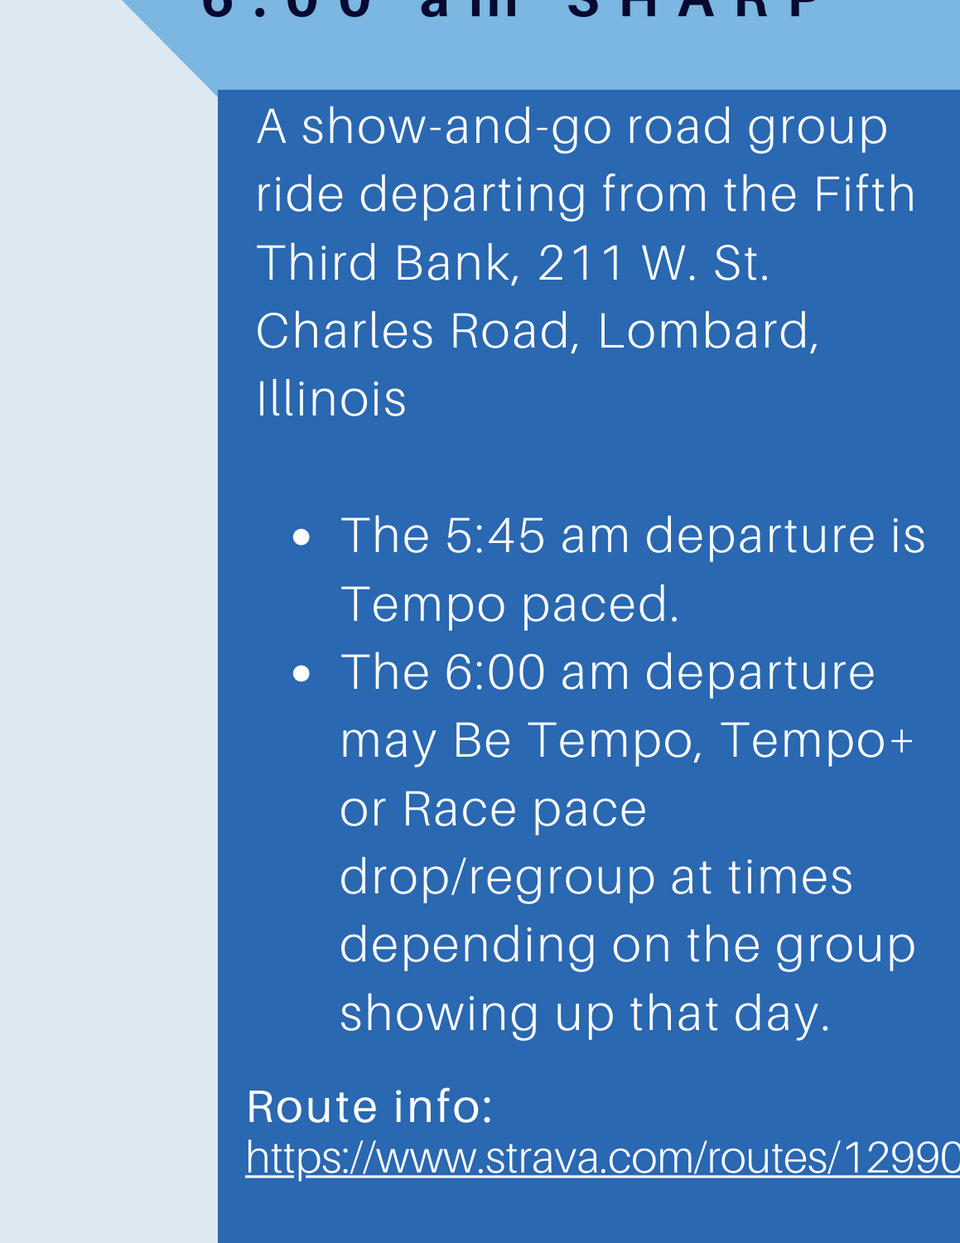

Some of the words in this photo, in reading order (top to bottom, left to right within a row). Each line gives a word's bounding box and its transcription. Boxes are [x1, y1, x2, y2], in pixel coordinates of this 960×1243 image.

[257, 109, 286, 143] A
[303, 106, 610, 154] show-and-go
[630, 106, 729, 144] road
[749, 116, 886, 154] group
[259, 174, 342, 212] ride
[361, 174, 583, 222] departing
[603, 173, 705, 212] from
[724, 174, 795, 212] the
[817, 173, 913, 211] Fifth
[257, 243, 375, 280] Third
[398, 243, 518, 286] Bank,
[539, 245, 617, 280] 211
[642, 245, 694, 280] W.
[715, 245, 767, 280] St.
[258, 311, 432, 348] Charles
[454, 311, 577, 354] Road,
[601, 311, 817, 354] Lombard,
[260, 379, 405, 416] Illinois
[341, 515, 428, 553] The
[447, 518, 543, 553] 5:45
[562, 525, 627, 553] am
[647, 516, 874, 562] departure
[894, 518, 924, 553] is
[341, 587, 504, 631] Tempo
[524, 584, 677, 631] paced.
[341, 652, 428, 690] The
[447, 654, 544, 690] 6:00
[562, 662, 627, 690] am
[647, 652, 874, 699] departure
[343, 730, 436, 767] may
[456, 722, 509, 758] Be
[528, 722, 700, 767] Tempo,
[721, 722, 912, 767] Tempo+
[341, 798, 386, 826] or
[406, 791, 515, 826] Race
[536, 798, 645, 835] pace
[341, 857, 654, 904] drop/regroup
[672, 861, 711, 894] at
[729, 859, 851, 894] times
[341, 925, 593, 972] depending
[614, 934, 668, 962] on
[687, 924, 759, 962] the
[777, 934, 914, 972] group
[341, 993, 536, 1041] showing
[558, 1003, 613, 1040] up
[630, 993, 718, 1031] that
[736, 993, 828, 1041] day.
[250, 1091, 376, 1123] Route
[396, 1088, 490, 1123] info:
